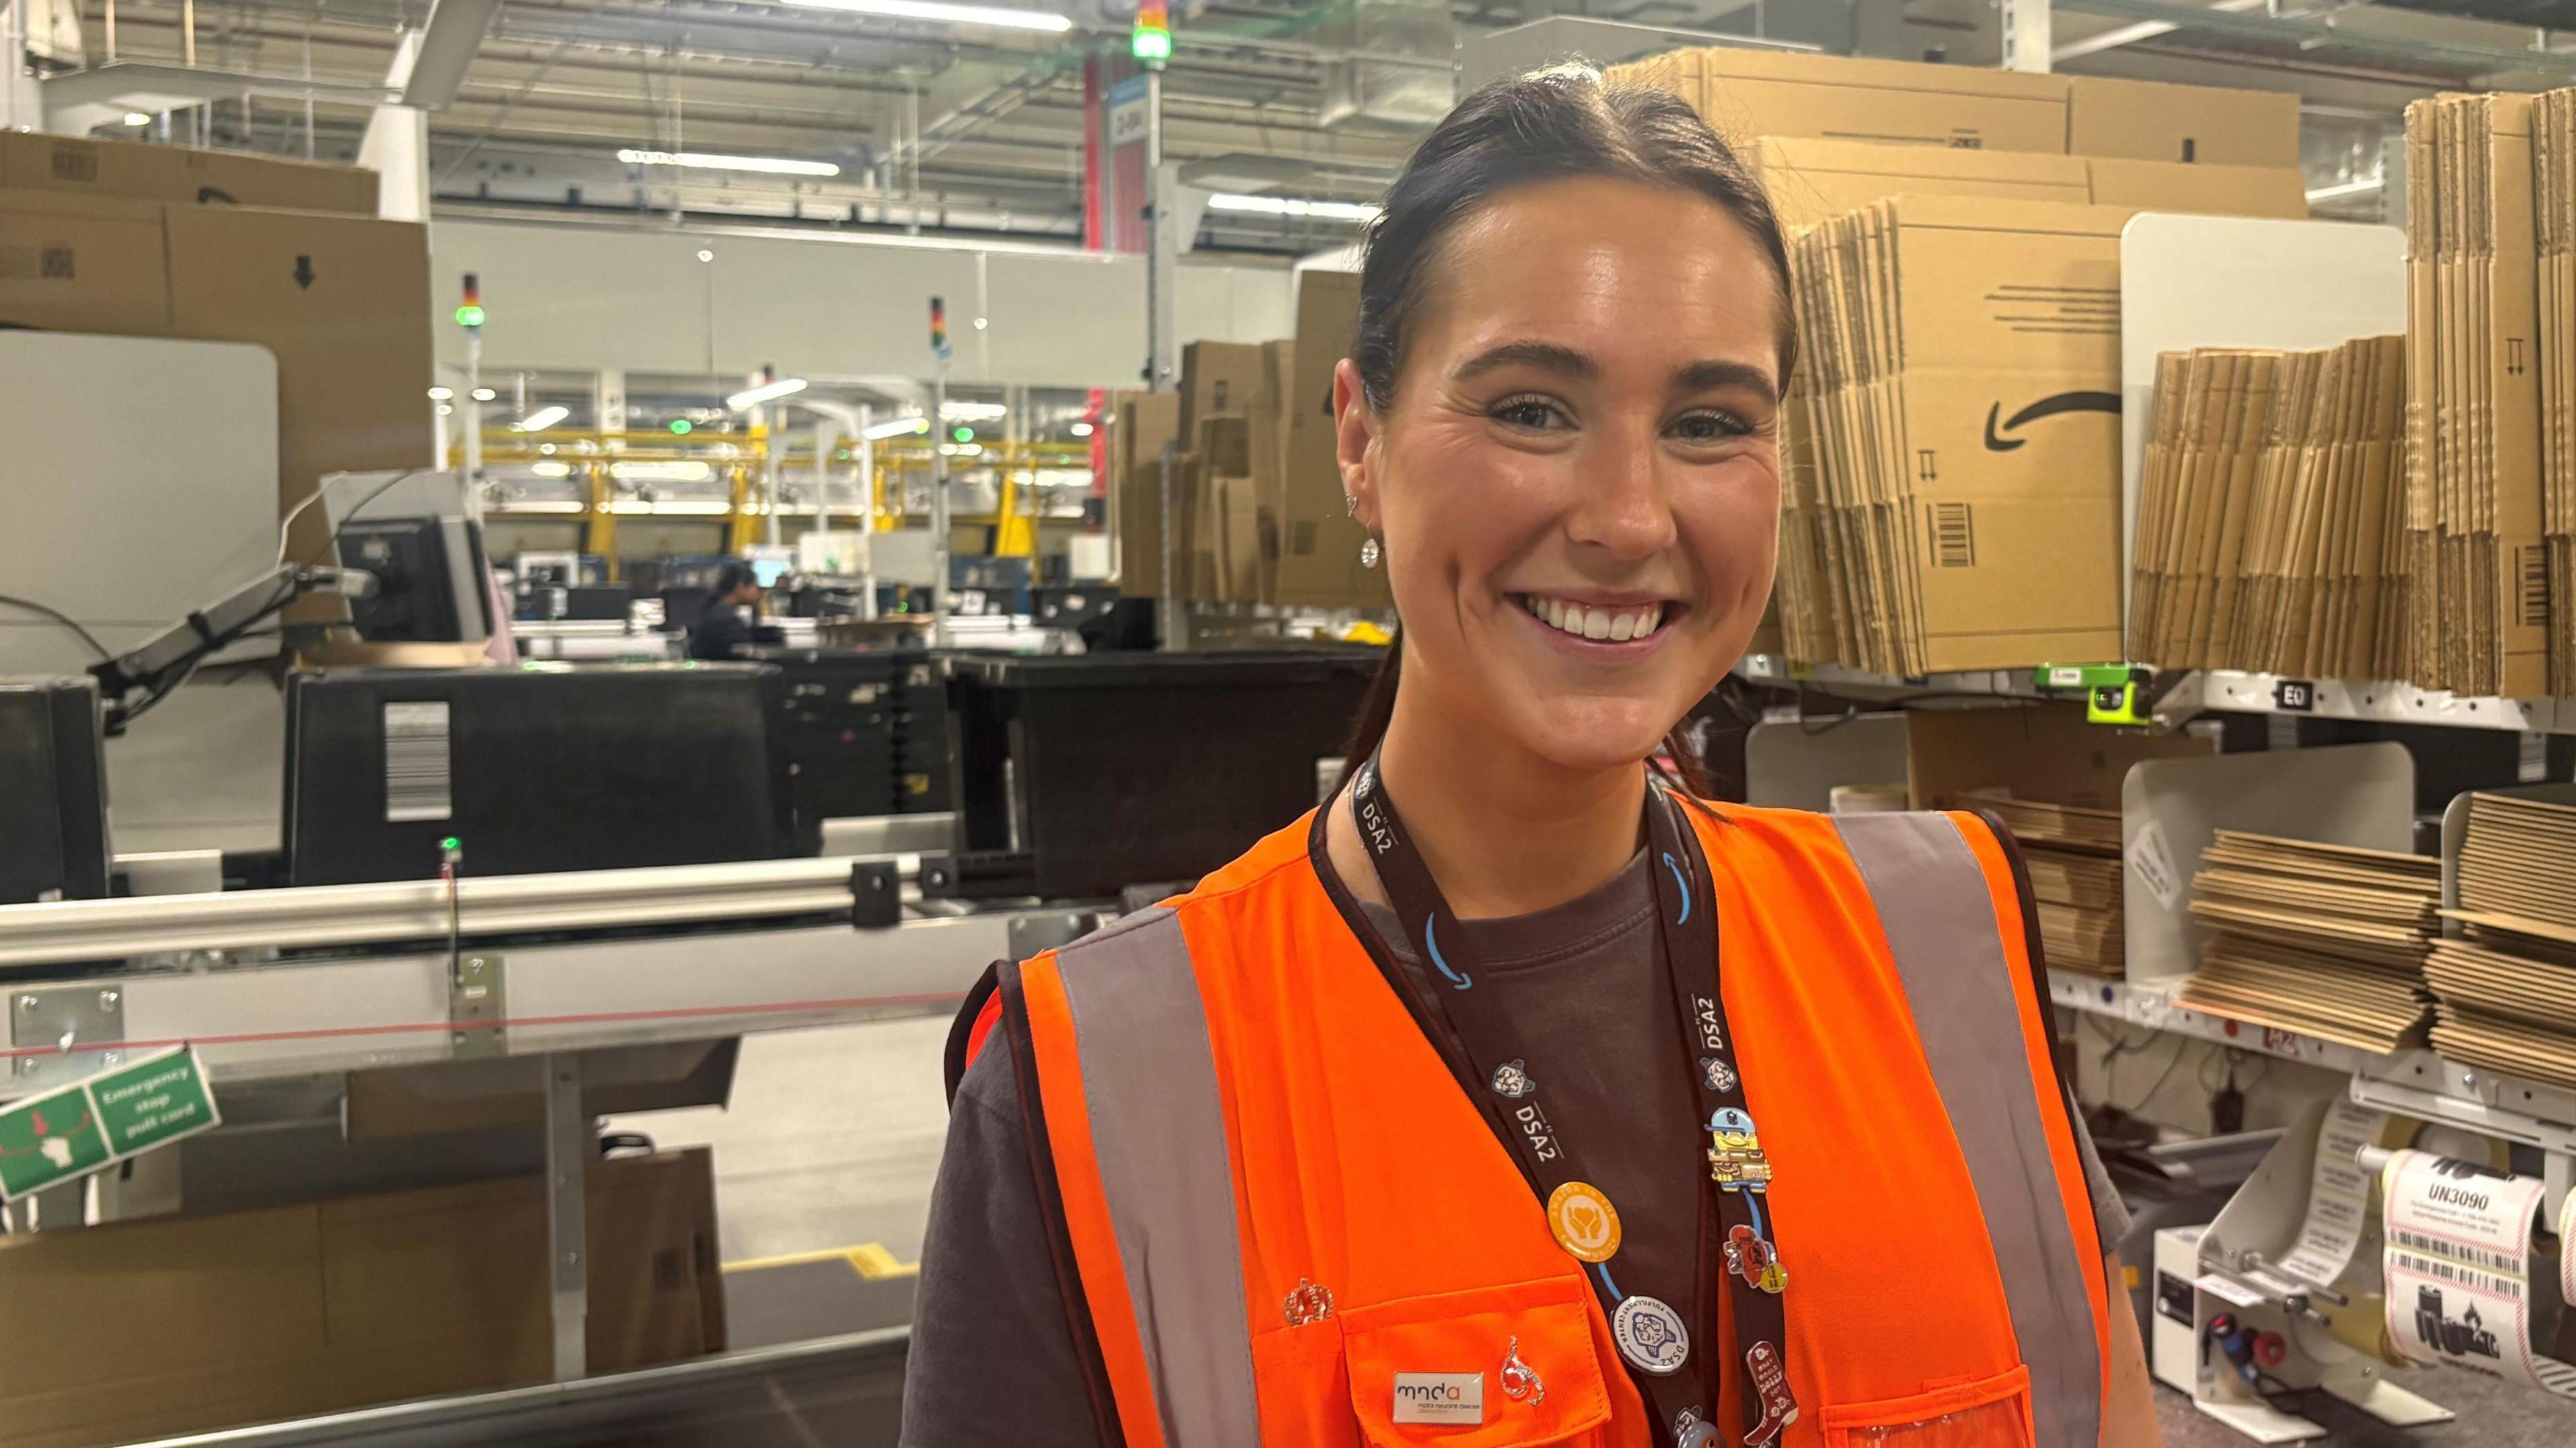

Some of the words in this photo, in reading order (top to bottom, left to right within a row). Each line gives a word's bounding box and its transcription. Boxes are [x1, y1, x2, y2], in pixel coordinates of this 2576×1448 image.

[1362, 802, 1392, 855] DSA2
[1697, 997, 1723, 1050] DSA2
[101, 1065, 189, 1105] Emergency
[136, 1093, 171, 1115] stop
[125, 1115, 158, 1139] pull
[160, 1102, 196, 1125] cord
[1515, 1105, 1556, 1162] DSA2
[2428, 1183, 2490, 1211] UN3090
[1660, 1345, 1685, 1366] DSA2
[1397, 1382, 1460, 1400] mnda
[1760, 1370, 1782, 1394] DOLLY
